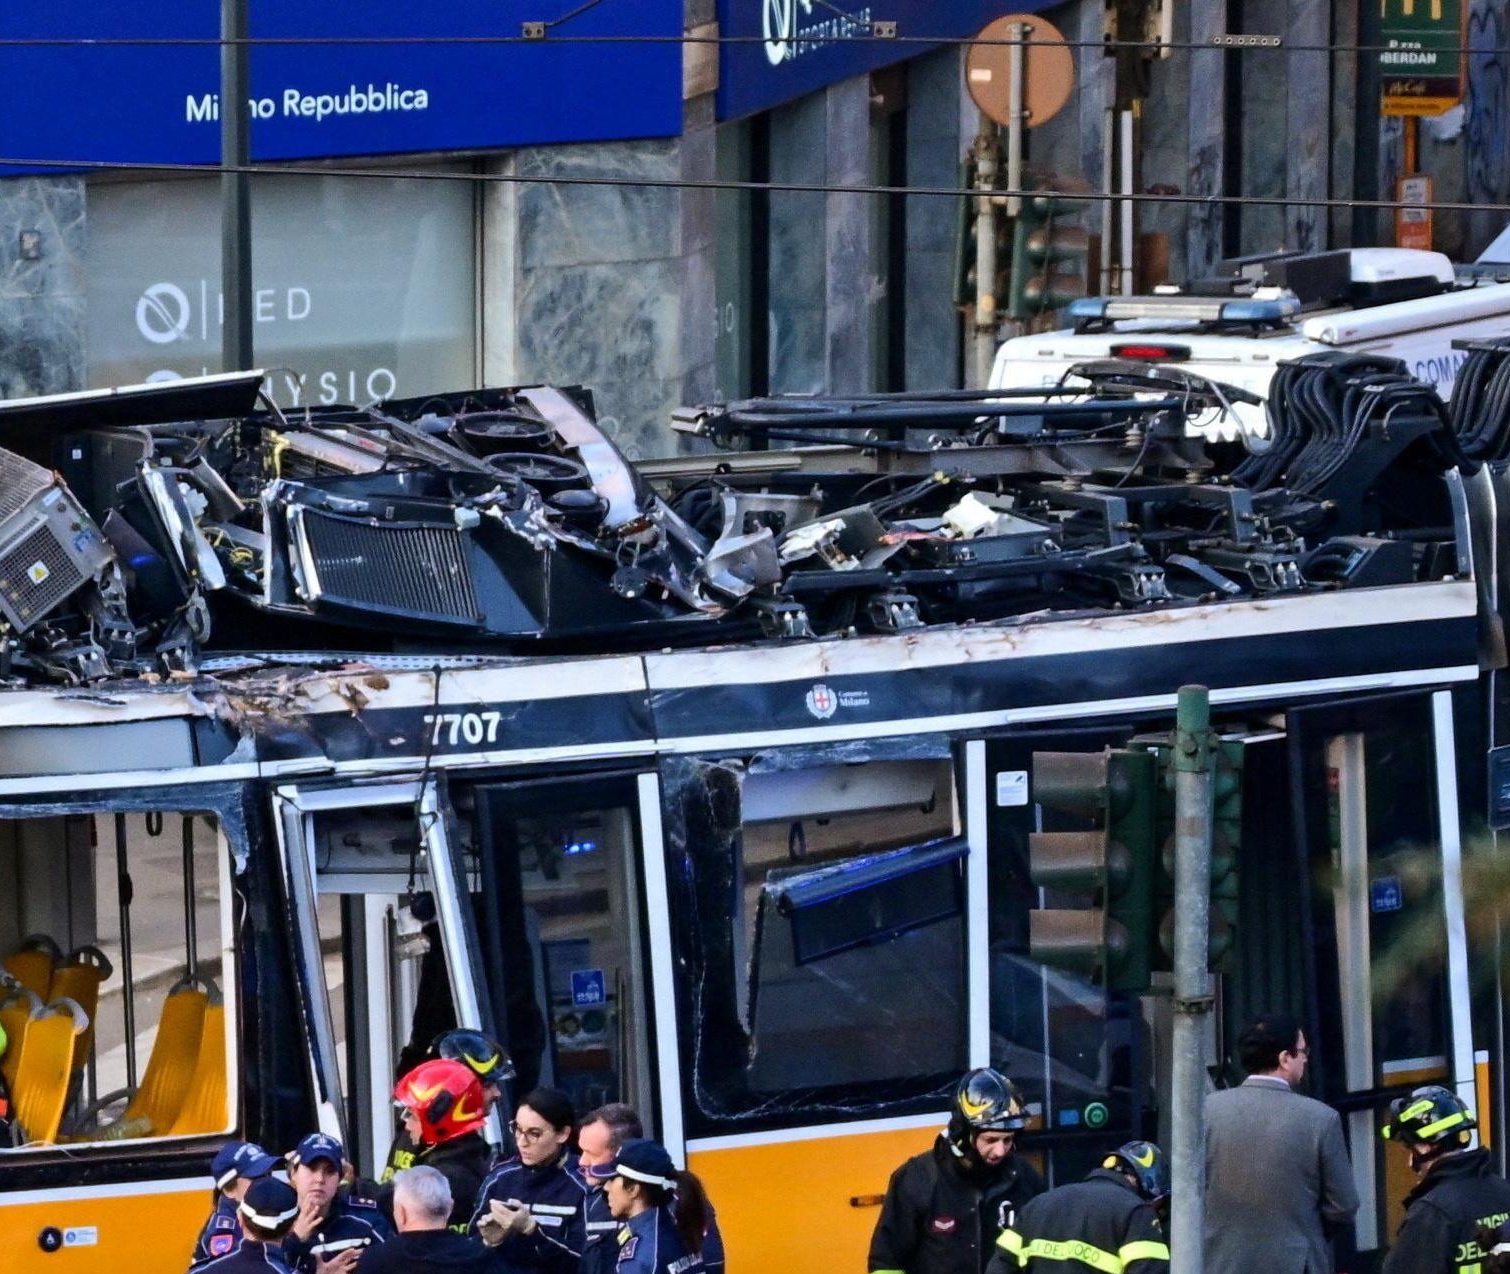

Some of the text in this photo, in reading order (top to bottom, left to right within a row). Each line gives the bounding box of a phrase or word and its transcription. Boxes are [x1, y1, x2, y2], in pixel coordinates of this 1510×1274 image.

[186, 82, 429, 122] Mino Repubblica
[263, 368, 396, 407] HYSIO
[423, 711, 501, 745] 7707
